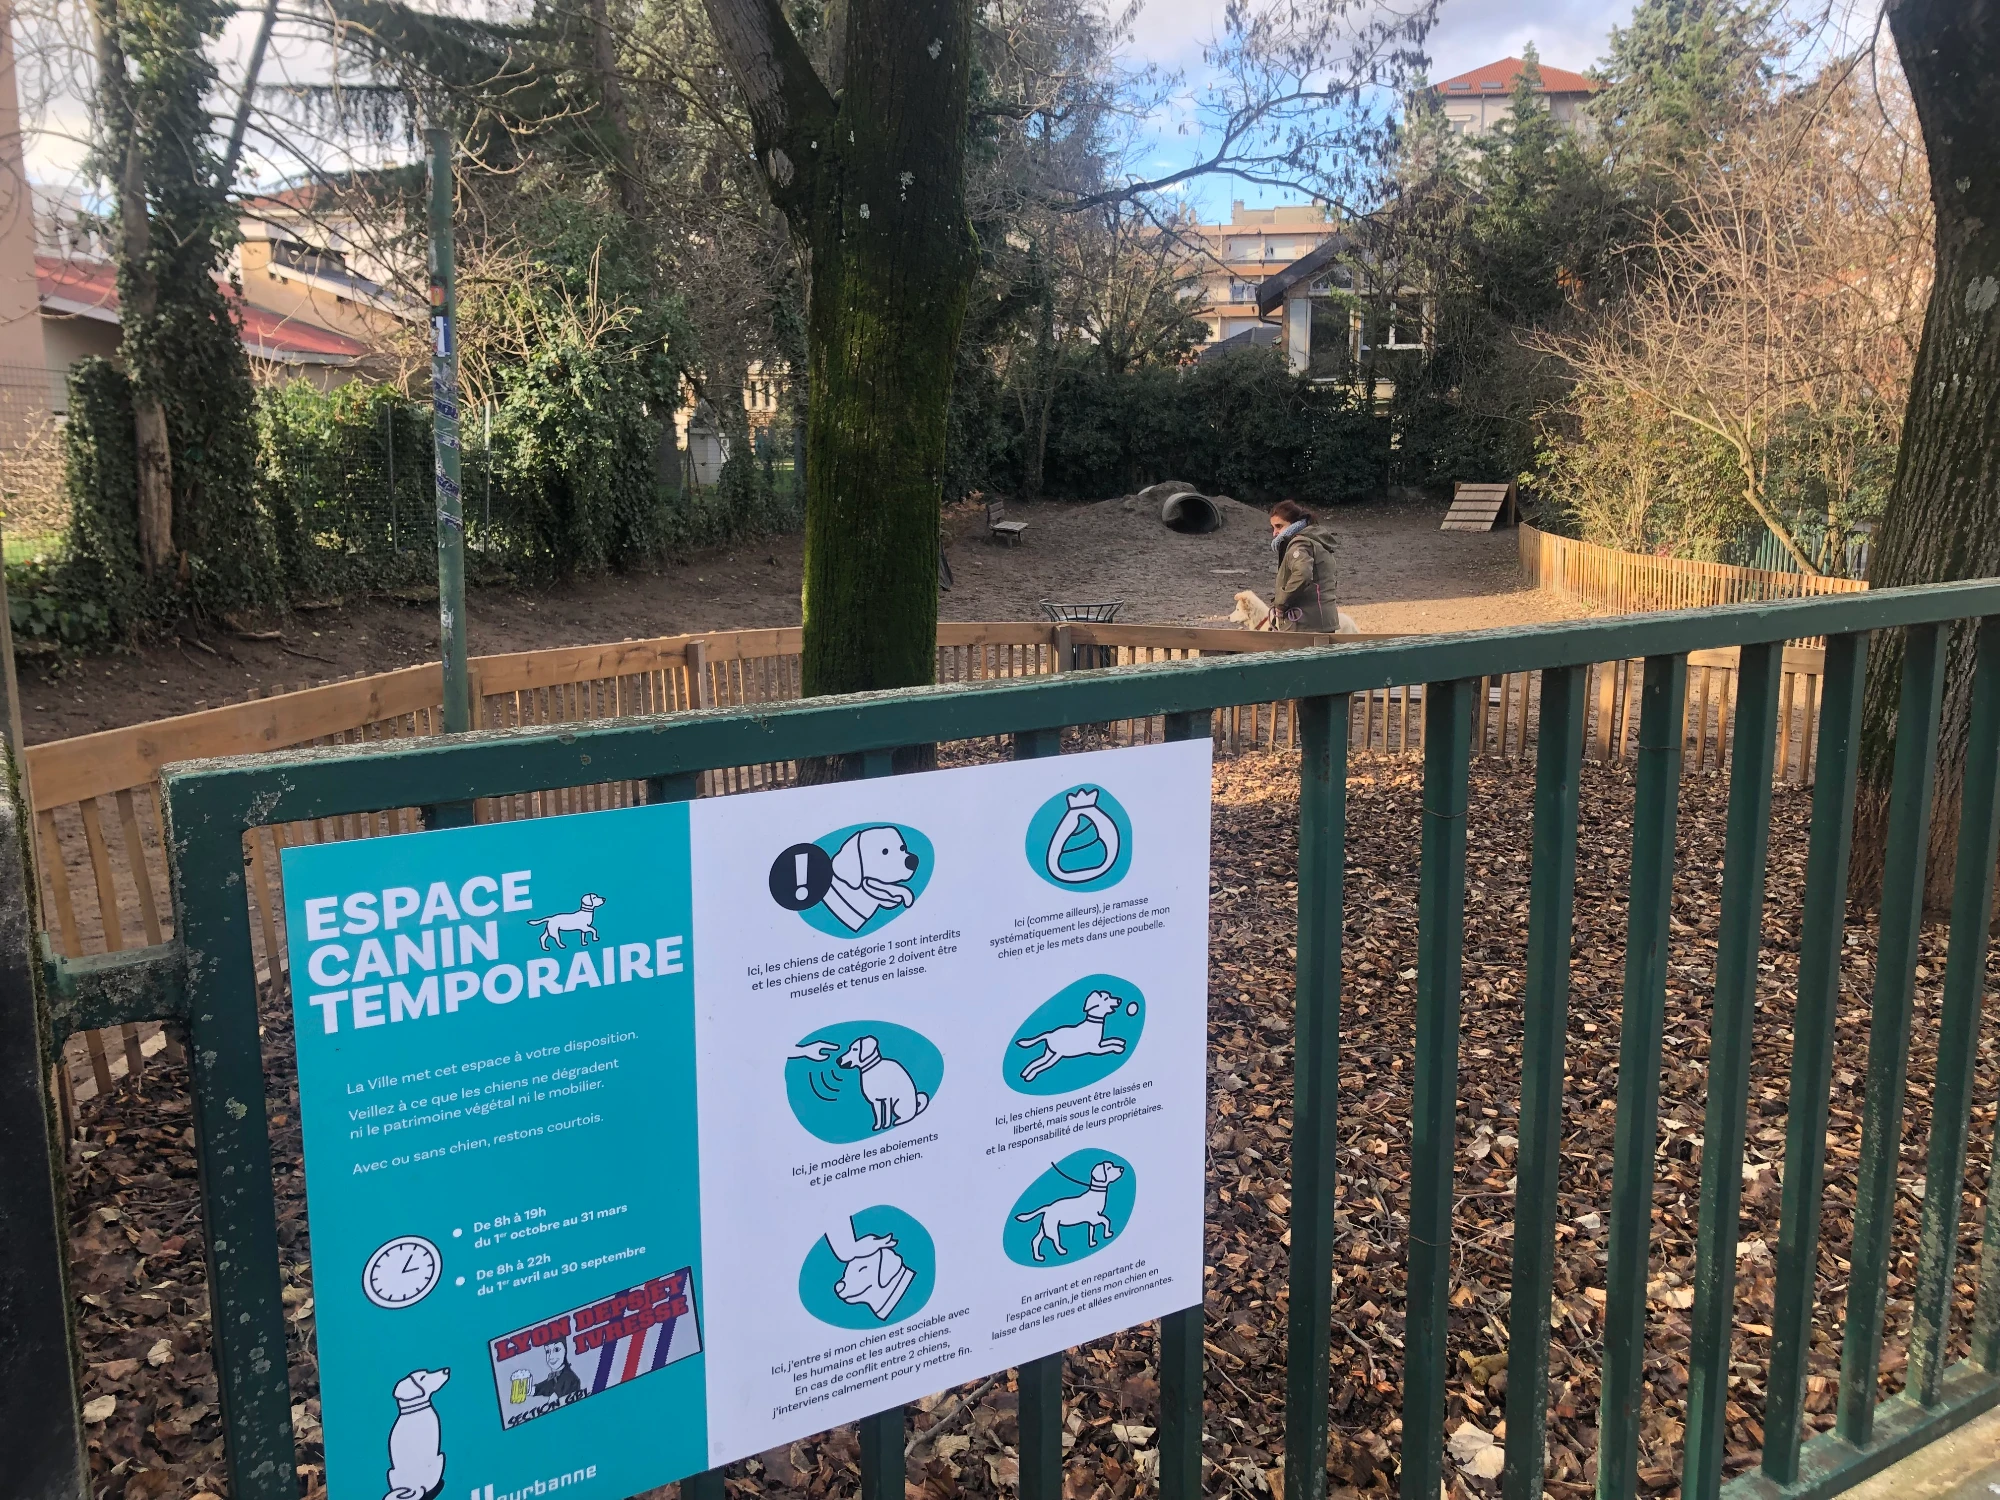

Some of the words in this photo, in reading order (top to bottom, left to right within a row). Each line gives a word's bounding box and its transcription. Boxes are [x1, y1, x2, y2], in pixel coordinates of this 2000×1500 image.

[305, 870, 532, 941] ESPACE
[990, 923, 1076, 948] systématiquement
[1077, 920, 1090, 930] les
[1091, 913, 1137, 928] déjections
[1138, 909, 1150, 918] de
[1151, 907, 1170, 916] mon
[1014, 917, 1025, 928] Ici
[1027, 912, 1064, 928] (comme
[1066, 904, 1102, 918] ailleurs),
[1102, 902, 1111, 914] je
[1112, 897, 1149, 910] ramasse
[308, 921, 498, 986] CANIN
[747, 964, 763, 976] Ici,
[765, 963, 781, 973] les
[783, 956, 819, 970] chiens
[821, 952, 835, 963] de
[837, 942, 886, 960] catégorie
[888, 941, 892, 950] 1
[895, 937, 918, 949] sont
[920, 929, 961, 944] interdits
[752, 980, 764, 991] et
[766, 978, 782, 988] les
[784, 971, 820, 985] chiens
[822, 966, 836, 978] de
[837, 957, 887, 975] catégorie
[888, 955, 895, 965] 2
[897, 948, 936, 963] doivent
[937, 945, 957, 955] être
[310, 936, 683, 1034] TEMPORAIRE
[790, 982, 834, 999] muselés
[836, 979, 848, 990] et
[850, 975, 880, 987] tenus
[881, 972, 895, 981] en
[897, 966, 927, 978] laisse.
[347, 1084, 364, 1094] La
[368, 1075, 398, 1089] Ville
[402, 1069, 431, 1083] met
[435, 1064, 457, 1077] cet
[461, 1056, 510, 1072] espace
[514, 1051, 522, 1062] à
[526, 1046, 560, 1059] votre
[564, 1032, 638, 1052] disposition.
[348, 1105, 394, 1121] Veillez
[398, 1100, 407, 1111] à
[411, 1099, 427, 1109] ce
[431, 1092, 458, 1106] que
[461, 1088, 480, 1099] les
[484, 1079, 528, 1094] chiens
[532, 1075, 548, 1084] ne
[552, 1059, 619, 1080] dégradent
[350, 1126, 363, 1139] ni
[367, 1124, 380, 1136] le
[383, 1109, 461, 1135] patrimoine
[465, 1095, 514, 1115] végétal
[519, 1092, 530, 1104] ni
[534, 1090, 545, 1101] le
[549, 1080, 604, 1098] mobilier.
[995, 1115, 1008, 1126] Ici,
[1010, 1113, 1023, 1122] les
[1024, 1105, 1054, 1118] chiens
[1055, 1094, 1092, 1113] peuvent
[1093, 1091, 1111, 1101] être
[1113, 1082, 1141, 1096] laissés
[1142, 1080, 1153, 1089] en
[986, 1146, 996, 1155] et
[998, 1143, 1006, 1152] la
[1008, 1125, 1071, 1150] responsabilité
[1072, 1123, 1084, 1133] de
[1086, 1118, 1107, 1129] leurs
[1108, 1104, 1163, 1126] propriétaires.
[1013, 1119, 1045, 1135] liberté,
[1046, 1114, 1068, 1127] mais
[1069, 1109, 1090, 1120] sous
[1091, 1105, 1100, 1115] le
[1101, 1096, 1136, 1112] contrôle
[353, 1160, 387, 1175] Avec
[392, 1156, 409, 1166] ou
[413, 1148, 446, 1161] sans
[449, 1139, 490, 1153] chien,
[494, 1127, 543, 1144] restons
[547, 1113, 603, 1132] courtois.
[792, 1164, 807, 1177] Ici,
[808, 1163, 819, 1175] je
[821, 1153, 861, 1169] modère
[863, 1149, 878, 1159] les
[879, 1133, 938, 1154] aboiements
[810, 1176, 821, 1186] et
[822, 1174, 833, 1186] je
[835, 1166, 867, 1180] calme
[868, 1159, 892, 1172] mon
[893, 1152, 923, 1165] chien.
[474, 1222, 491, 1233] De
[494, 1215, 511, 1228] 8h
[513, 1212, 522, 1223] à
[524, 1207, 546, 1220] 19h
[474, 1237, 491, 1249] du
[510, 1222, 560, 1240] octobre
[563, 1217, 578, 1227] au
[581, 1210, 594, 1222] 31
[597, 1205, 627, 1218] mars
[476, 1270, 494, 1281] De
[496, 1263, 513, 1275] 8h
[516, 1260, 524, 1270] à
[527, 1253, 551, 1268] 22h
[477, 1284, 494, 1296] du
[513, 1271, 540, 1287] avril
[543, 1269, 558, 1279] au
[561, 1262, 578, 1274] 30
[581, 1246, 646, 1269] septembre
[1021, 1295, 1032, 1305] En
[1034, 1283, 1068, 1301] arrivant
[1070, 1280, 1079, 1289] et
[1081, 1277, 1092, 1286] en
[1093, 1263, 1134, 1282] repartant
[1135, 1259, 1146, 1268] de
[494, 1315, 571, 1362] LYON
[648, 1275, 683, 1302] ET
[573, 1295, 688, 1355] IVRESSE
[771, 1363, 786, 1375] Ici,
[787, 1354, 821, 1373] j'entre
[823, 1348, 832, 1359] si
[834, 1343, 857, 1356] mon
[859, 1334, 886, 1348] chien
[888, 1327, 904, 1338] est
[906, 1314, 946, 1333] sociable
[948, 1308, 970, 1320] avec
[793, 1372, 808, 1382] les
[810, 1357, 854, 1377] humains
[856, 1352, 867, 1362] et
[869, 1348, 883, 1358] les
[885, 1338, 916, 1353] autres
[918, 1327, 951, 1347] chiens.
[795, 1386, 808, 1396] En
[810, 1379, 828, 1391] cas
[830, 1374, 844, 1384] de
[845, 1362, 878, 1379] conflit
[880, 1354, 906, 1368] entre
[908, 1350, 915, 1360] 2
[917, 1341, 950, 1356] chiens,
[772, 1393, 829, 1420] j'interviens
[831, 1372, 889, 1397] calmement
[891, 1365, 914, 1381] pour
[915, 1363, 921, 1373] y
[923, 1352, 956, 1368] mettre
[958, 1347, 972, 1357] fin.
[508, 1400, 560, 1427] SECTION
